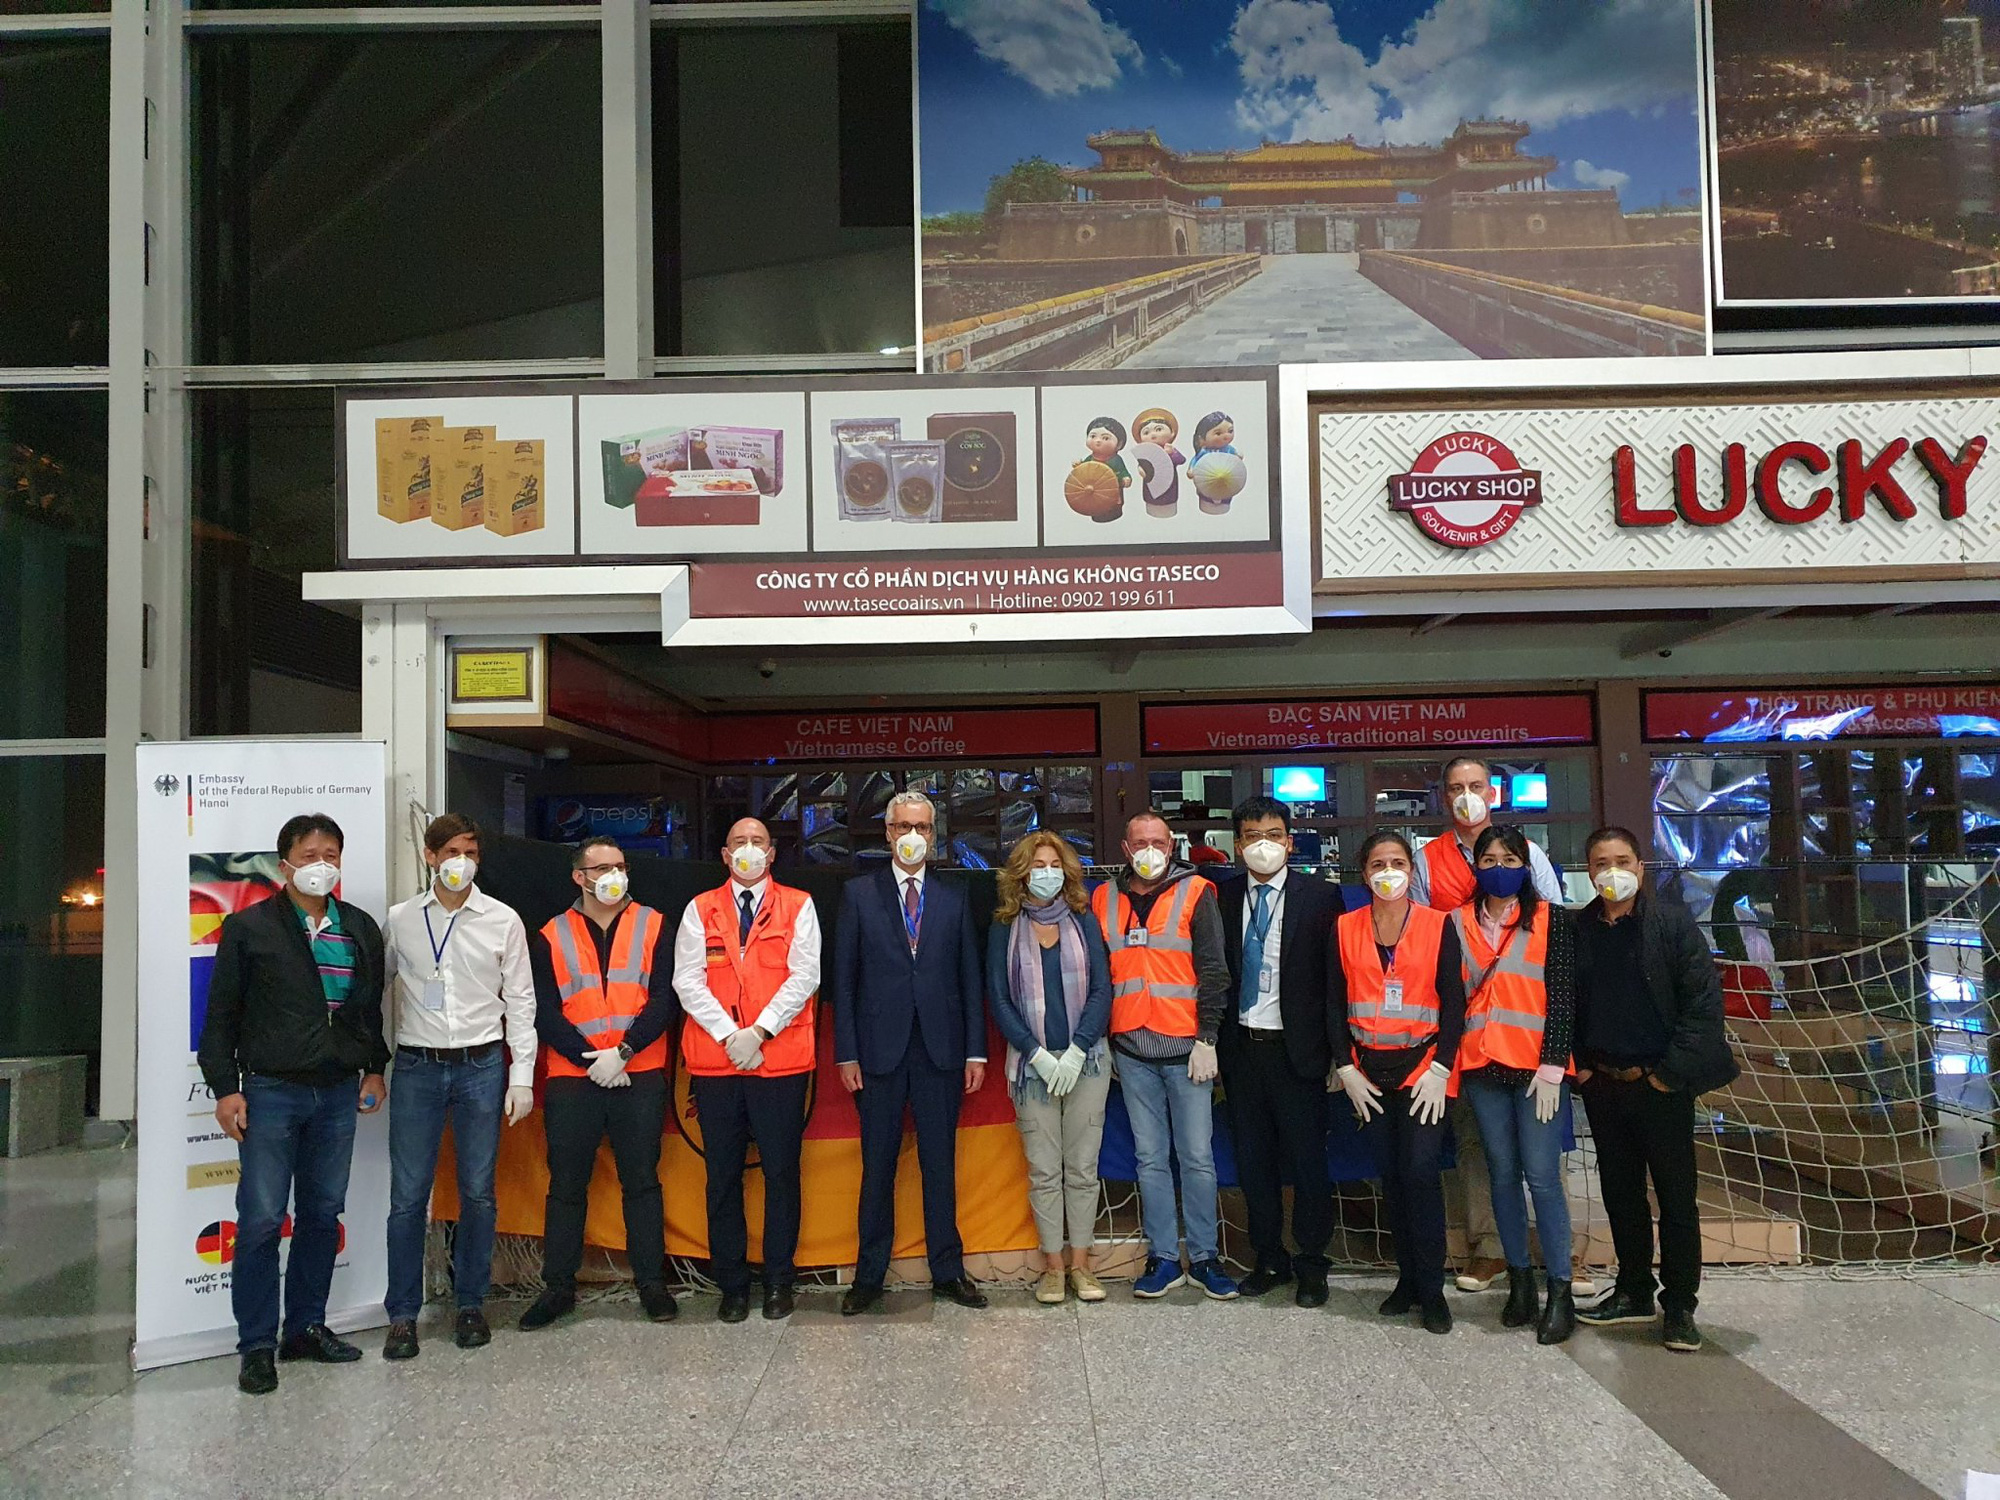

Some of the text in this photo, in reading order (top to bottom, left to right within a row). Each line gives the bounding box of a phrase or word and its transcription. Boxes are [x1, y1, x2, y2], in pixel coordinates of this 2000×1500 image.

[1434, 437, 1497, 457] LUCKY
[1400, 478, 1536, 500] LUCKY SHOP
[1612, 435, 1988, 527] LUCKY
[1422, 510, 1513, 542] SOUVENIR & GIFT
[756, 564, 1220, 591] CÔNG TY CỔ PHẦN DỊCH VỤ HÀNG KHÔNG TASECO
[804, 595, 964, 611] www.tasecoairs.vn
[990, 592, 1057, 609] Hotline:
[1061, 591, 1103, 608] 0902
[1110, 590, 1140, 606] 199
[1144, 590, 1174, 605] 611
[1804, 693, 1875, 711] TRANG
[1883, 693, 1898, 709] &
[1904, 692, 1947, 712] PHỤ
[1367, 704, 1413, 725] VIỆT
[1420, 703, 1466, 720] NAM
[797, 716, 953, 738] CAFE VIỆT NAM
[1206, 725, 1529, 748] Vietnamese traditional souvenirs
[785, 737, 966, 757] Vietnamese Coffee
[199, 774, 245, 784] Embassy
[199, 785, 372, 796] of the Federal Republic of Germany
[199, 798, 229, 808] Hanoi
[588, 804, 653, 824] pepsi
[195, 1283, 218, 1294] VIỆT
